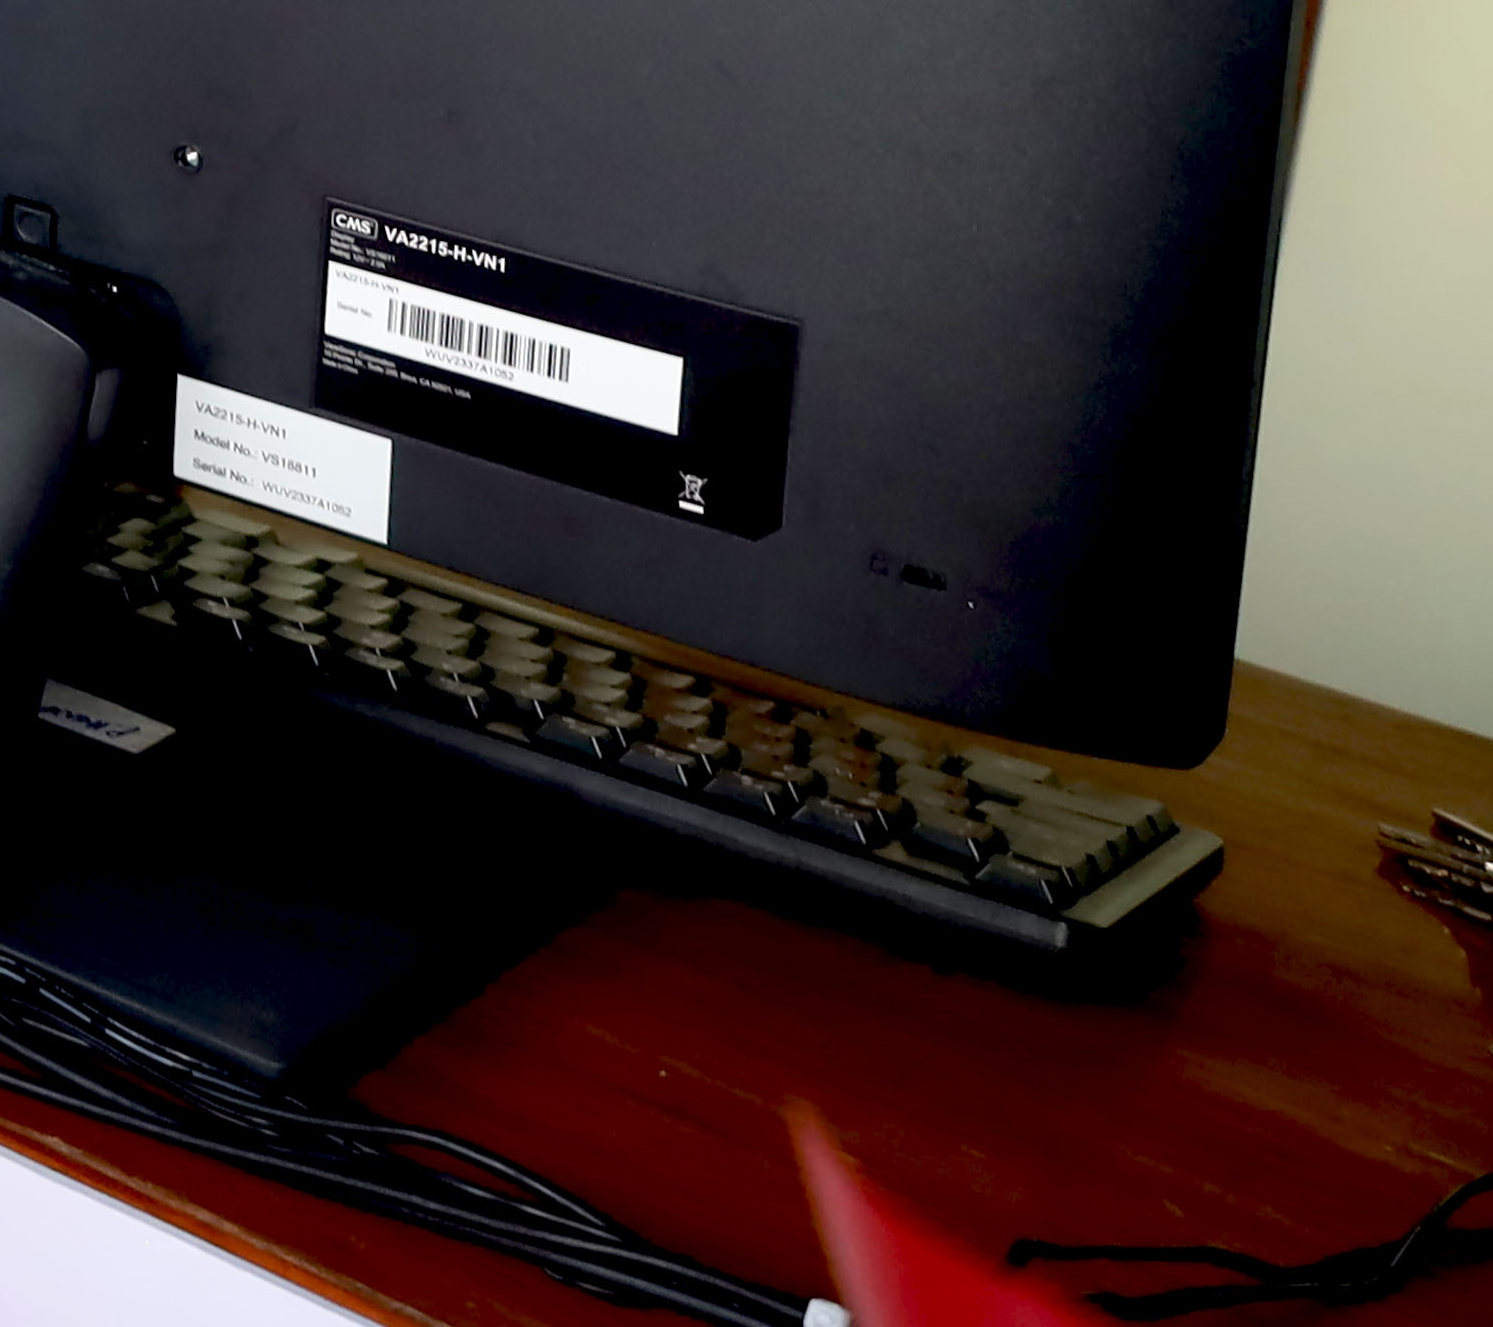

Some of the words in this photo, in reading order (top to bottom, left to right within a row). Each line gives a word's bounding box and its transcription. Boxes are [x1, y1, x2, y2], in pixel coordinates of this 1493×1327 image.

[335, 213, 373, 236] CMS
[383, 225, 507, 274] VA2215-H-VN1
[194, 399, 288, 441] VA2215-H-VN1
[193, 428, 231, 452] Model
[192, 457, 227, 478] Serial
